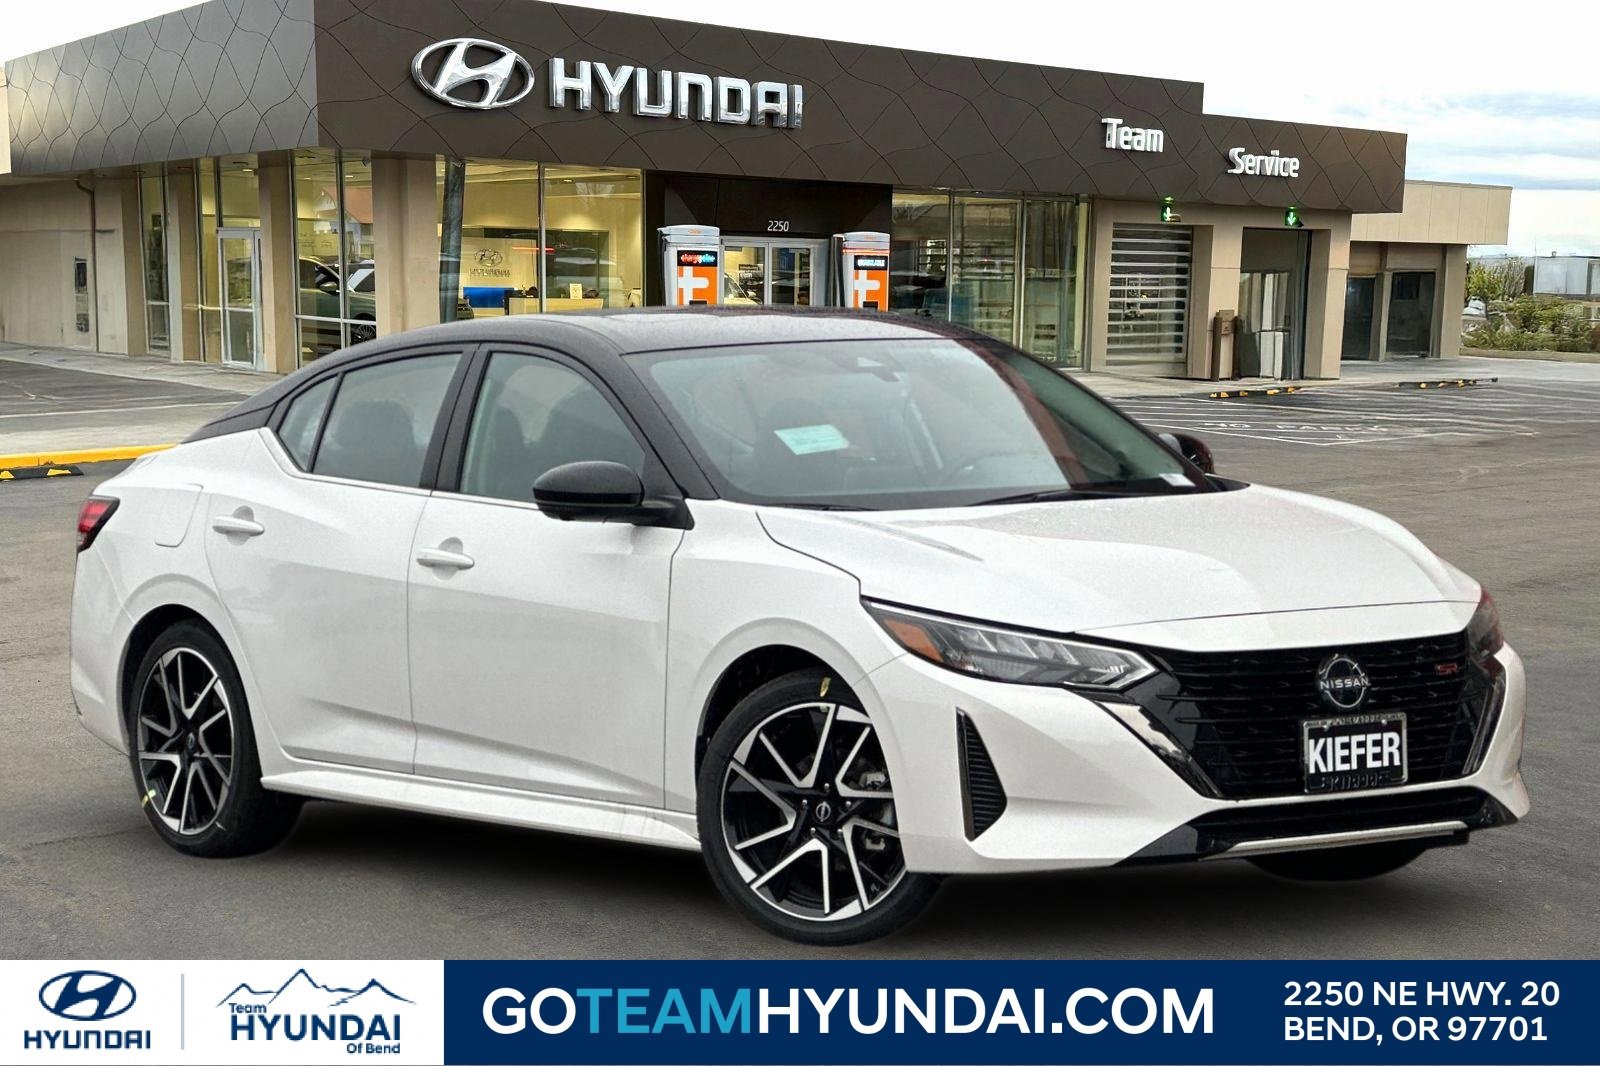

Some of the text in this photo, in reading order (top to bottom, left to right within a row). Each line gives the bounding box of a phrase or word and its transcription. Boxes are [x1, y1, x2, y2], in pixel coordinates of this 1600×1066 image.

[549, 57, 803, 129] HYUNDAI
[1101, 117, 1164, 153] Team
[1227, 147, 1300, 178] Service
[767, 220, 790, 232] 2250
[1319, 677, 1370, 690] NISSAN
[1308, 731, 1401, 774] KIEFER
